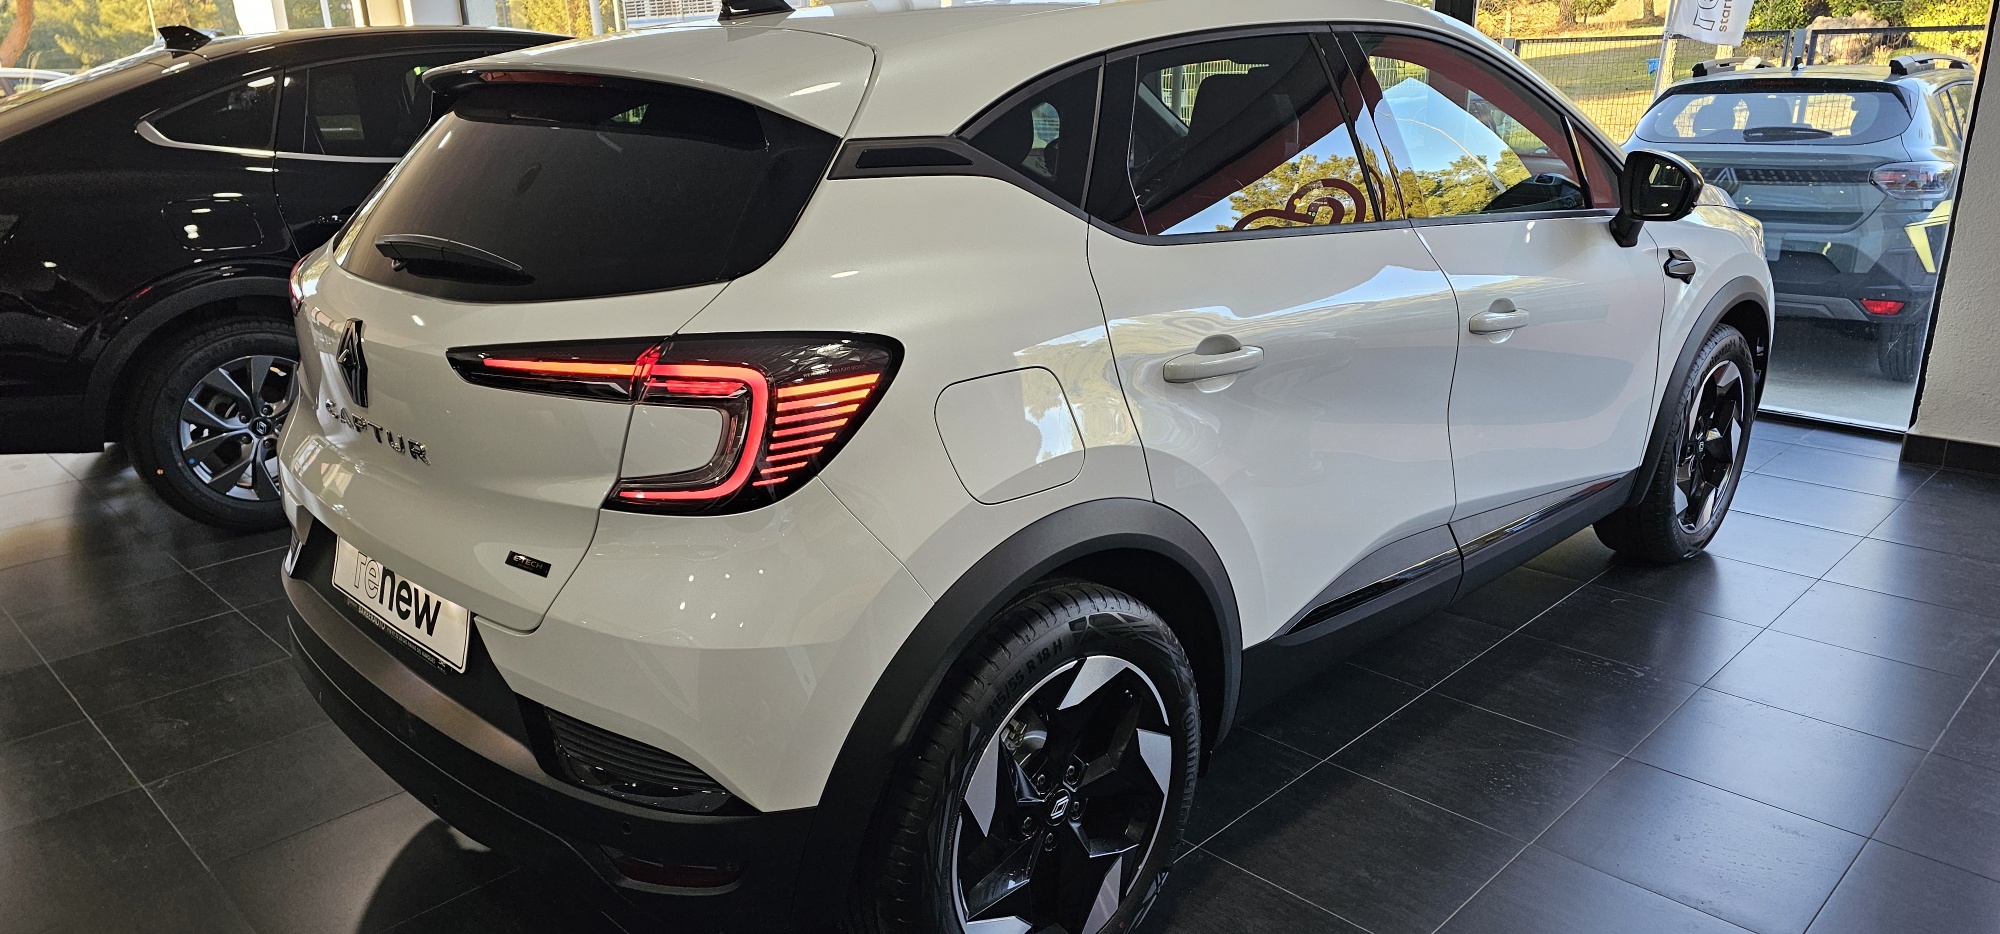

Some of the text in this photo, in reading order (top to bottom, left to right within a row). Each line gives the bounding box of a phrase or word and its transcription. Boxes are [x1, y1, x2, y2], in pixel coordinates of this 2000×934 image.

[325, 399, 431, 466] CAPTUR
[354, 551, 442, 637] renew
[986, 638, 1063, 719] 215/55 R 18 H
